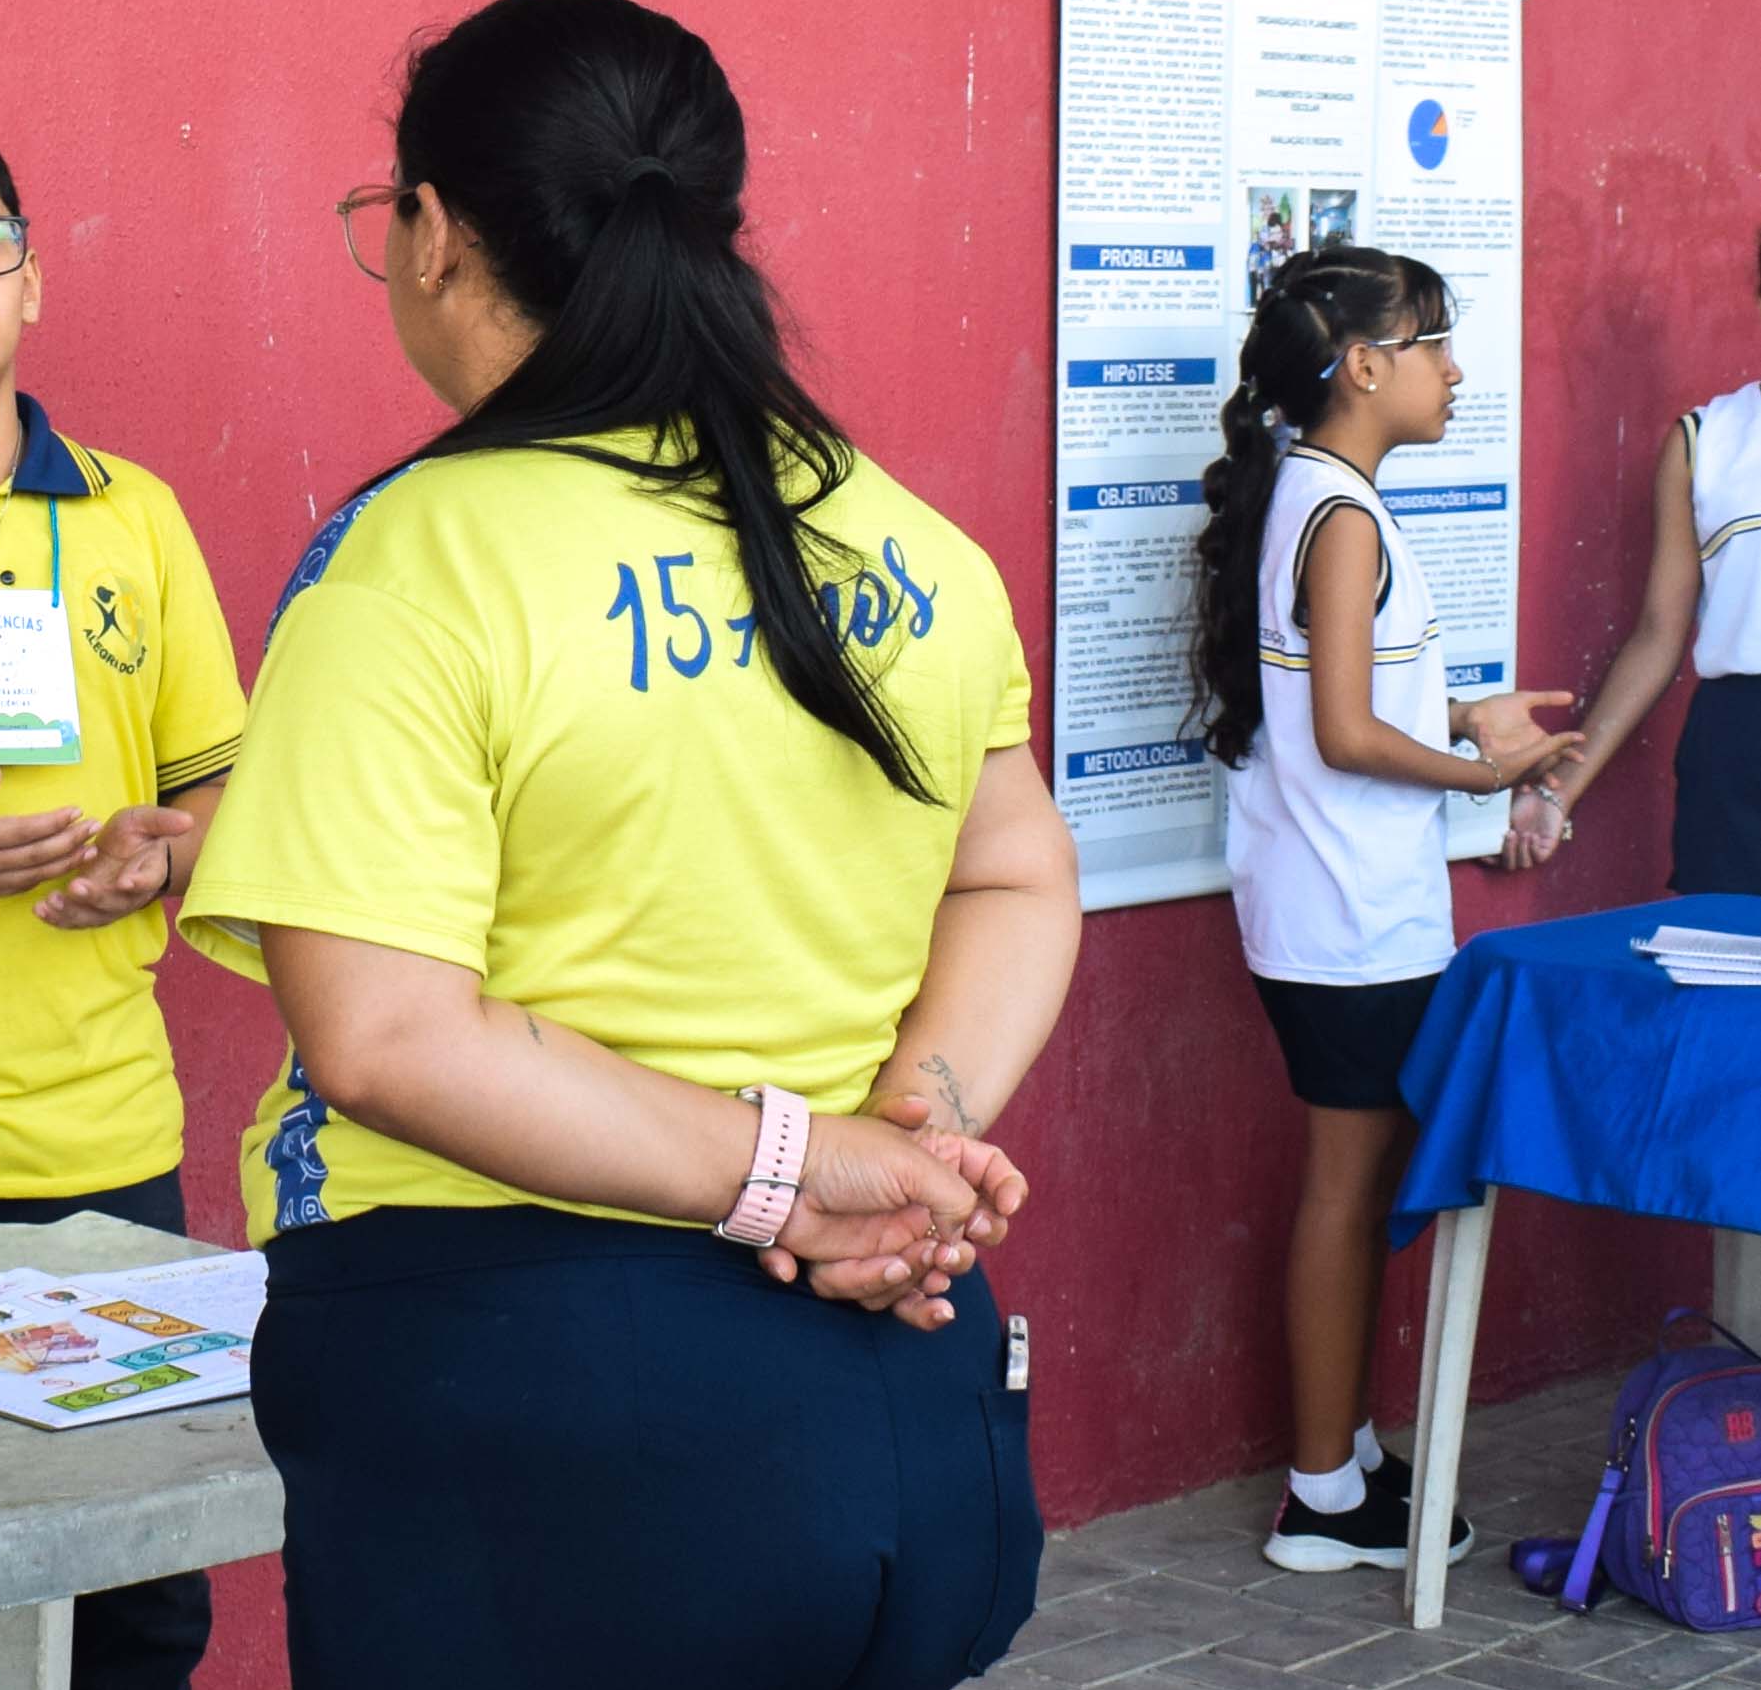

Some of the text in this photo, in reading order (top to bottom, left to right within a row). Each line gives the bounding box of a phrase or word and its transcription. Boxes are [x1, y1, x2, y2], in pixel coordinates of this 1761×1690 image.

[1099, 249, 1187, 268] PROBLEMA
[1097, 484, 1179, 507] OBJETIVOS
[606, 552, 712, 692] 15
[1084, 743, 1188, 774] METODOLOGIA
